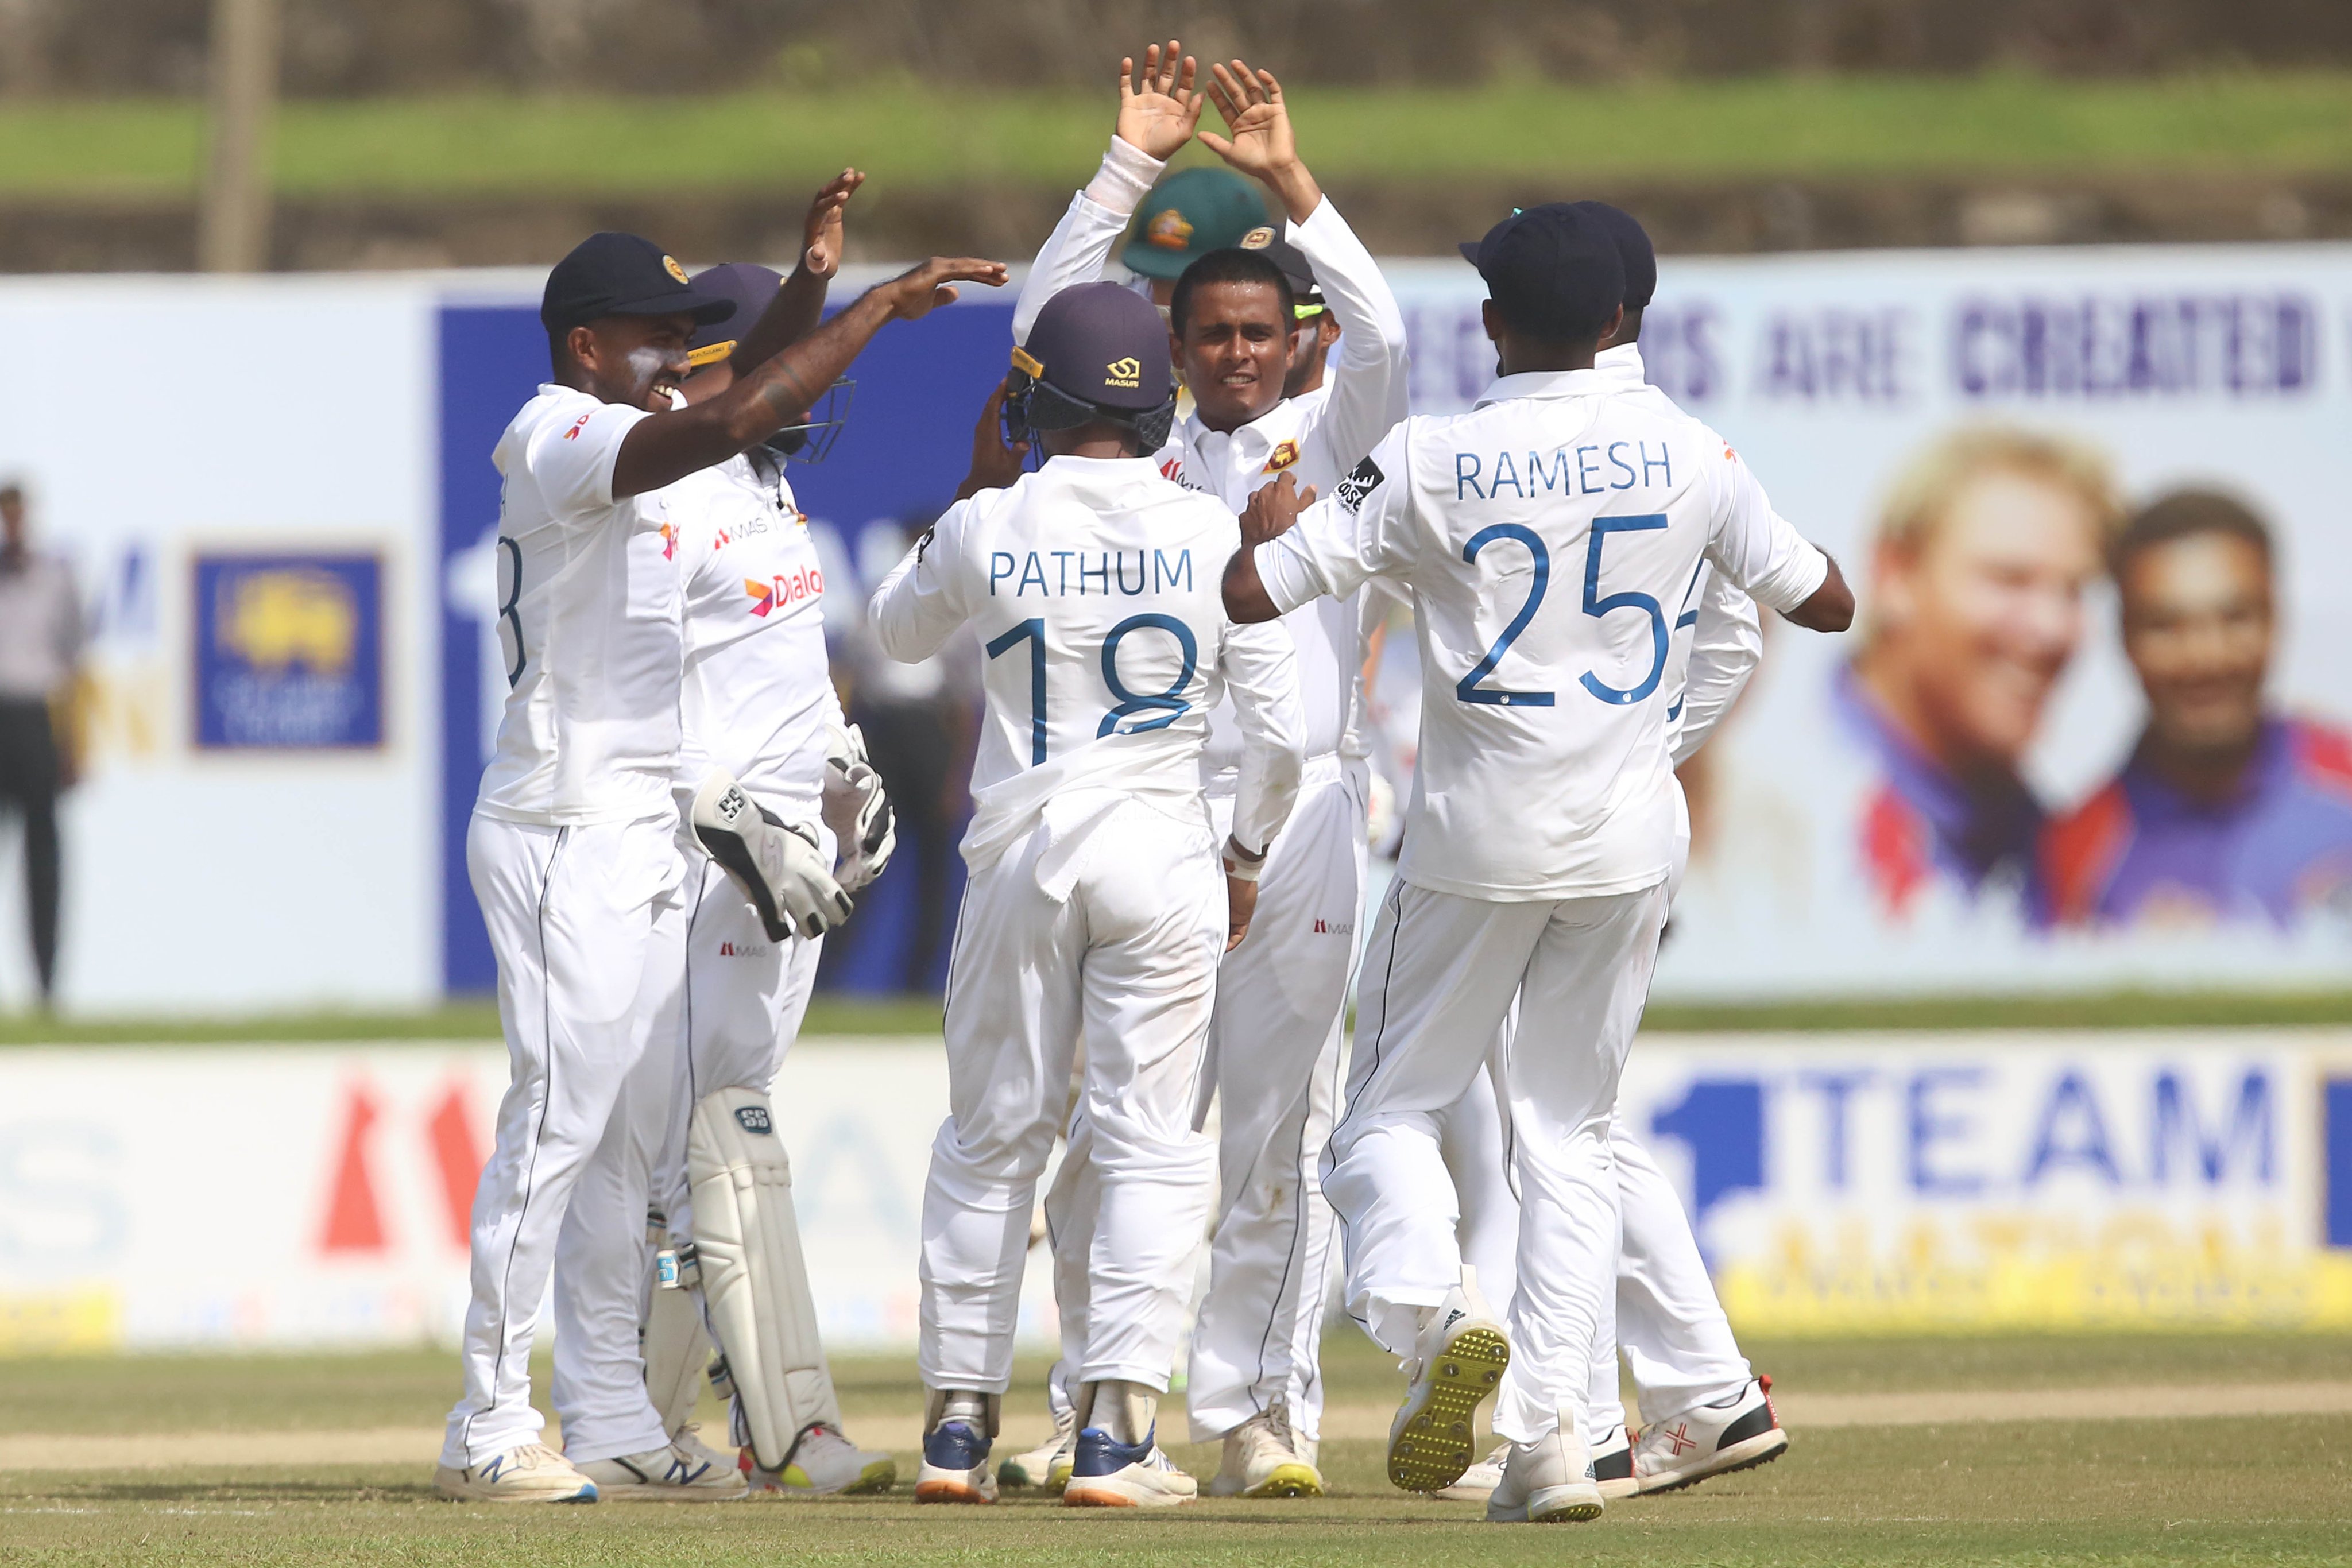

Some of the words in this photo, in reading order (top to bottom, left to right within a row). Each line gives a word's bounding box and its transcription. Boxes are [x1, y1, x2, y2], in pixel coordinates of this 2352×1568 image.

[1949, 292, 2318, 396] CREATED
[1105, 377, 1139, 388] MASURI
[1456, 440, 1673, 501] RAMESH
[1337, 482, 1364, 512] oose
[730, 517, 768, 541] MAS
[773, 563, 824, 609] Dialo
[989, 548, 1193, 597] PATHUM
[1456, 513, 1670, 707] 25
[985, 613, 1198, 768] 18
[740, 1109, 768, 1128] SS
[1783, 1064, 2275, 1197] TEAM
